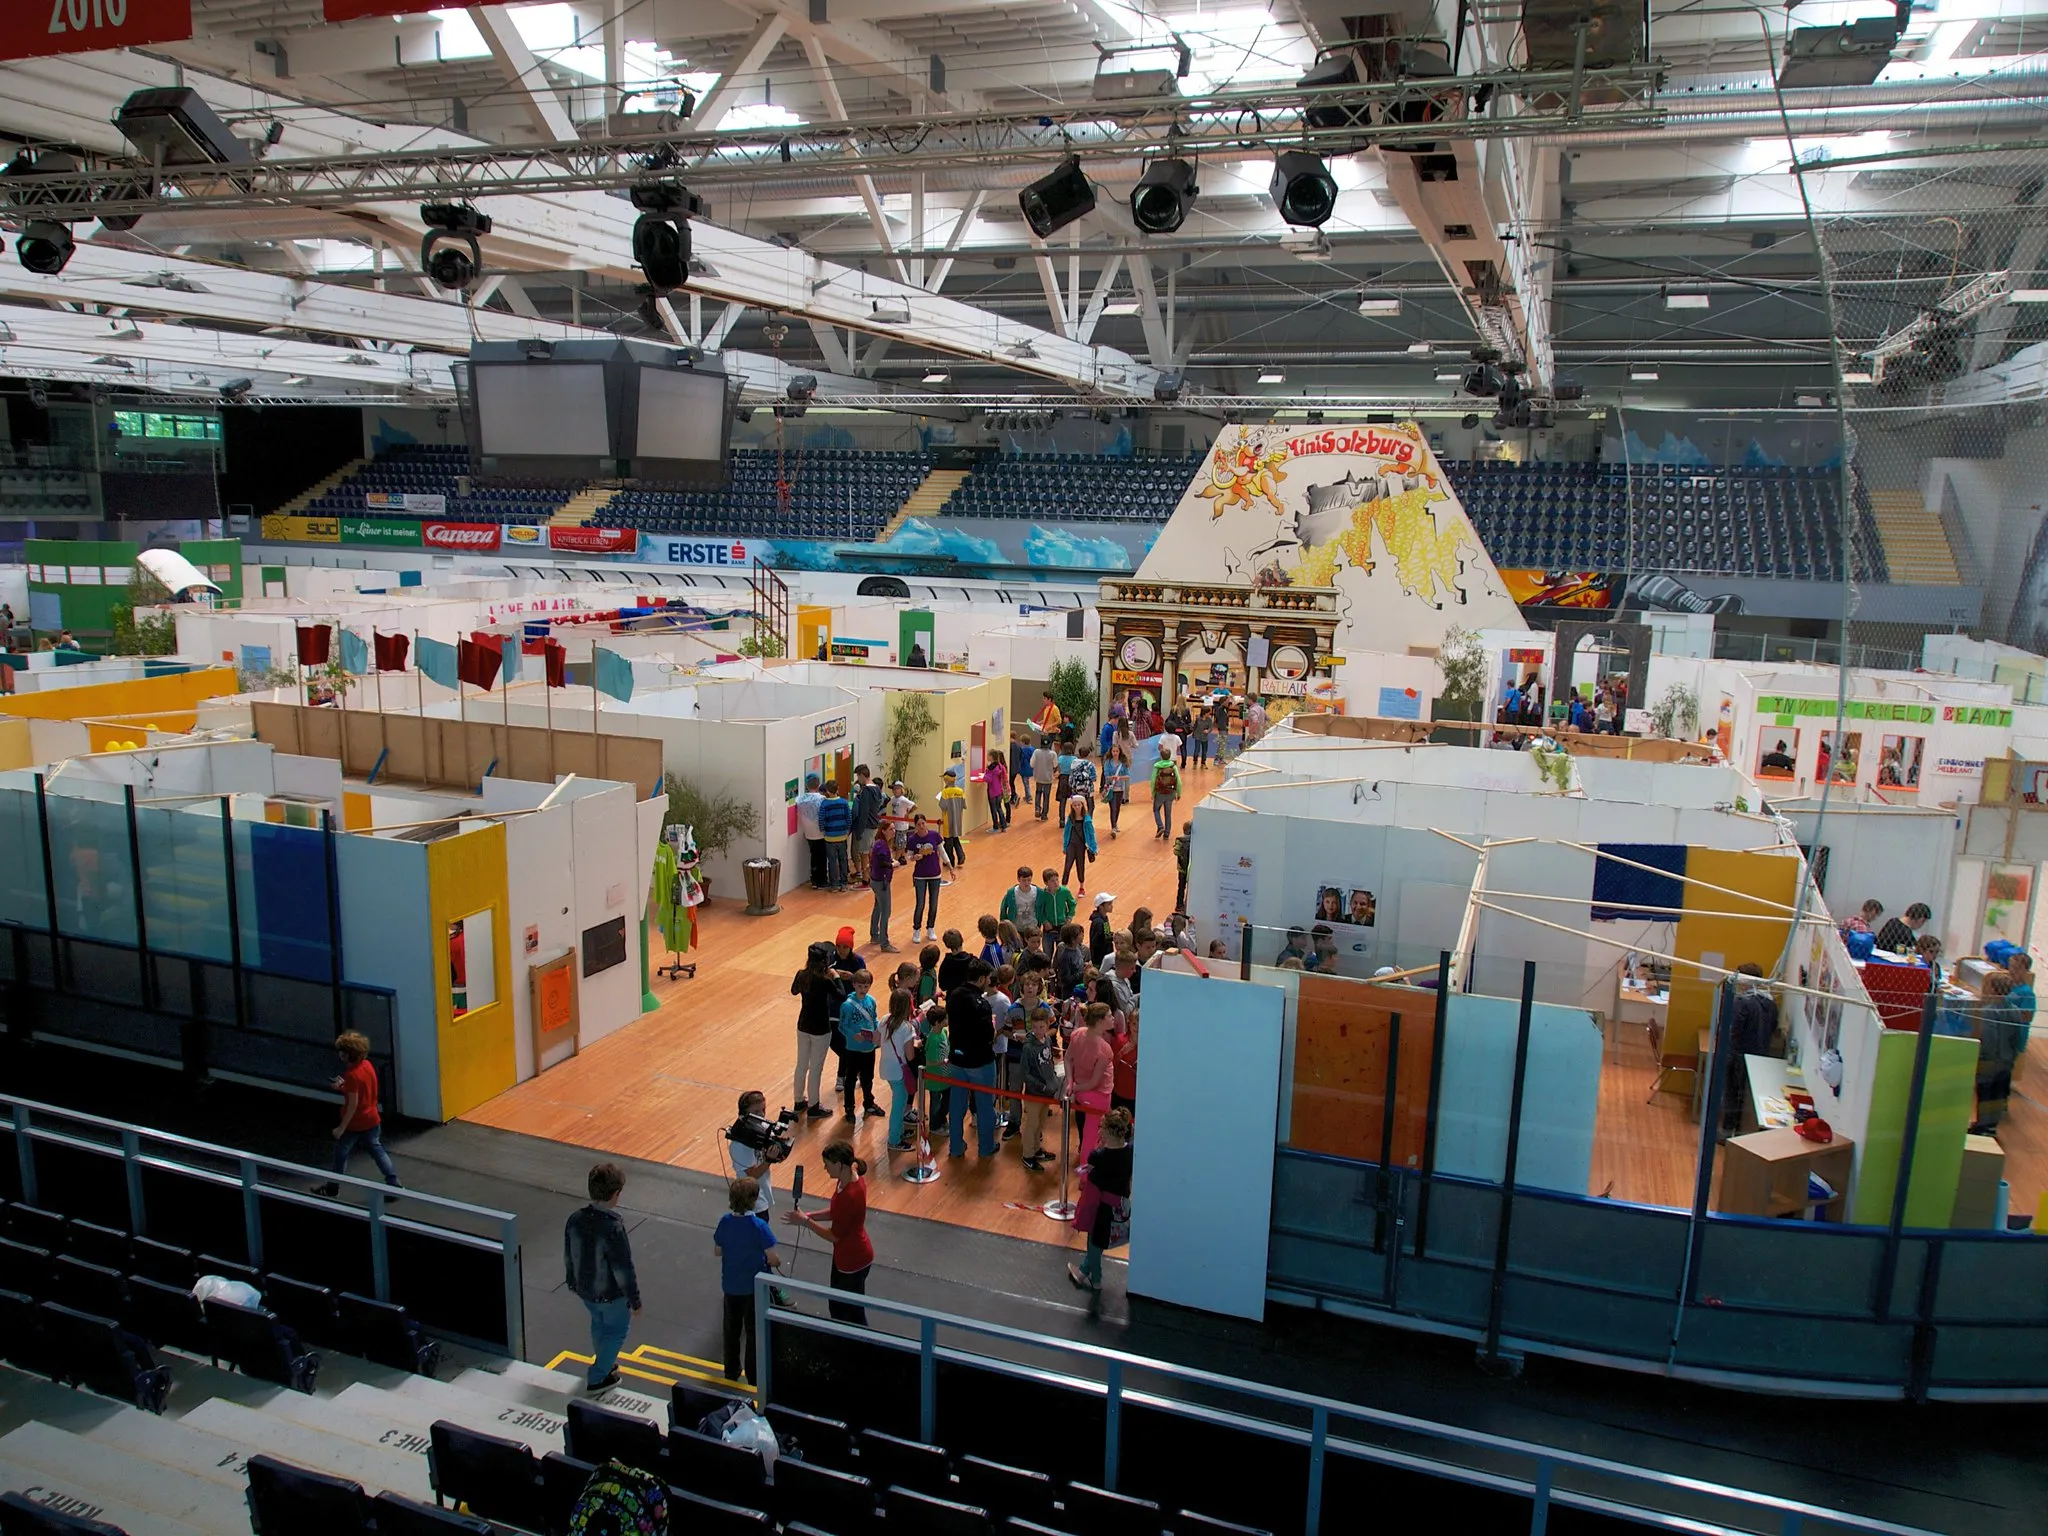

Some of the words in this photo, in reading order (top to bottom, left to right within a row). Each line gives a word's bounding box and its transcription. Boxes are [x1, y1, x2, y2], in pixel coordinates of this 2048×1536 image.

[48, 0, 127, 33] 2010
[1285, 430, 1414, 462] MiniSalzburg
[344, 525, 354, 533] Der
[383, 527, 391, 535] ist
[393, 528, 418, 536] meiner.
[426, 525, 494, 544] Carrera
[668, 543, 727, 564] ERSTE
[1949, 608, 1968, 619] WC
[1262, 680, 1307, 695] RATHAUS
[498, 1408, 512, 1421] 2
[511, 1412, 563, 1435] REIHE
[379, 1429, 393, 1443] 3
[216, 1452, 238, 1467] 4
